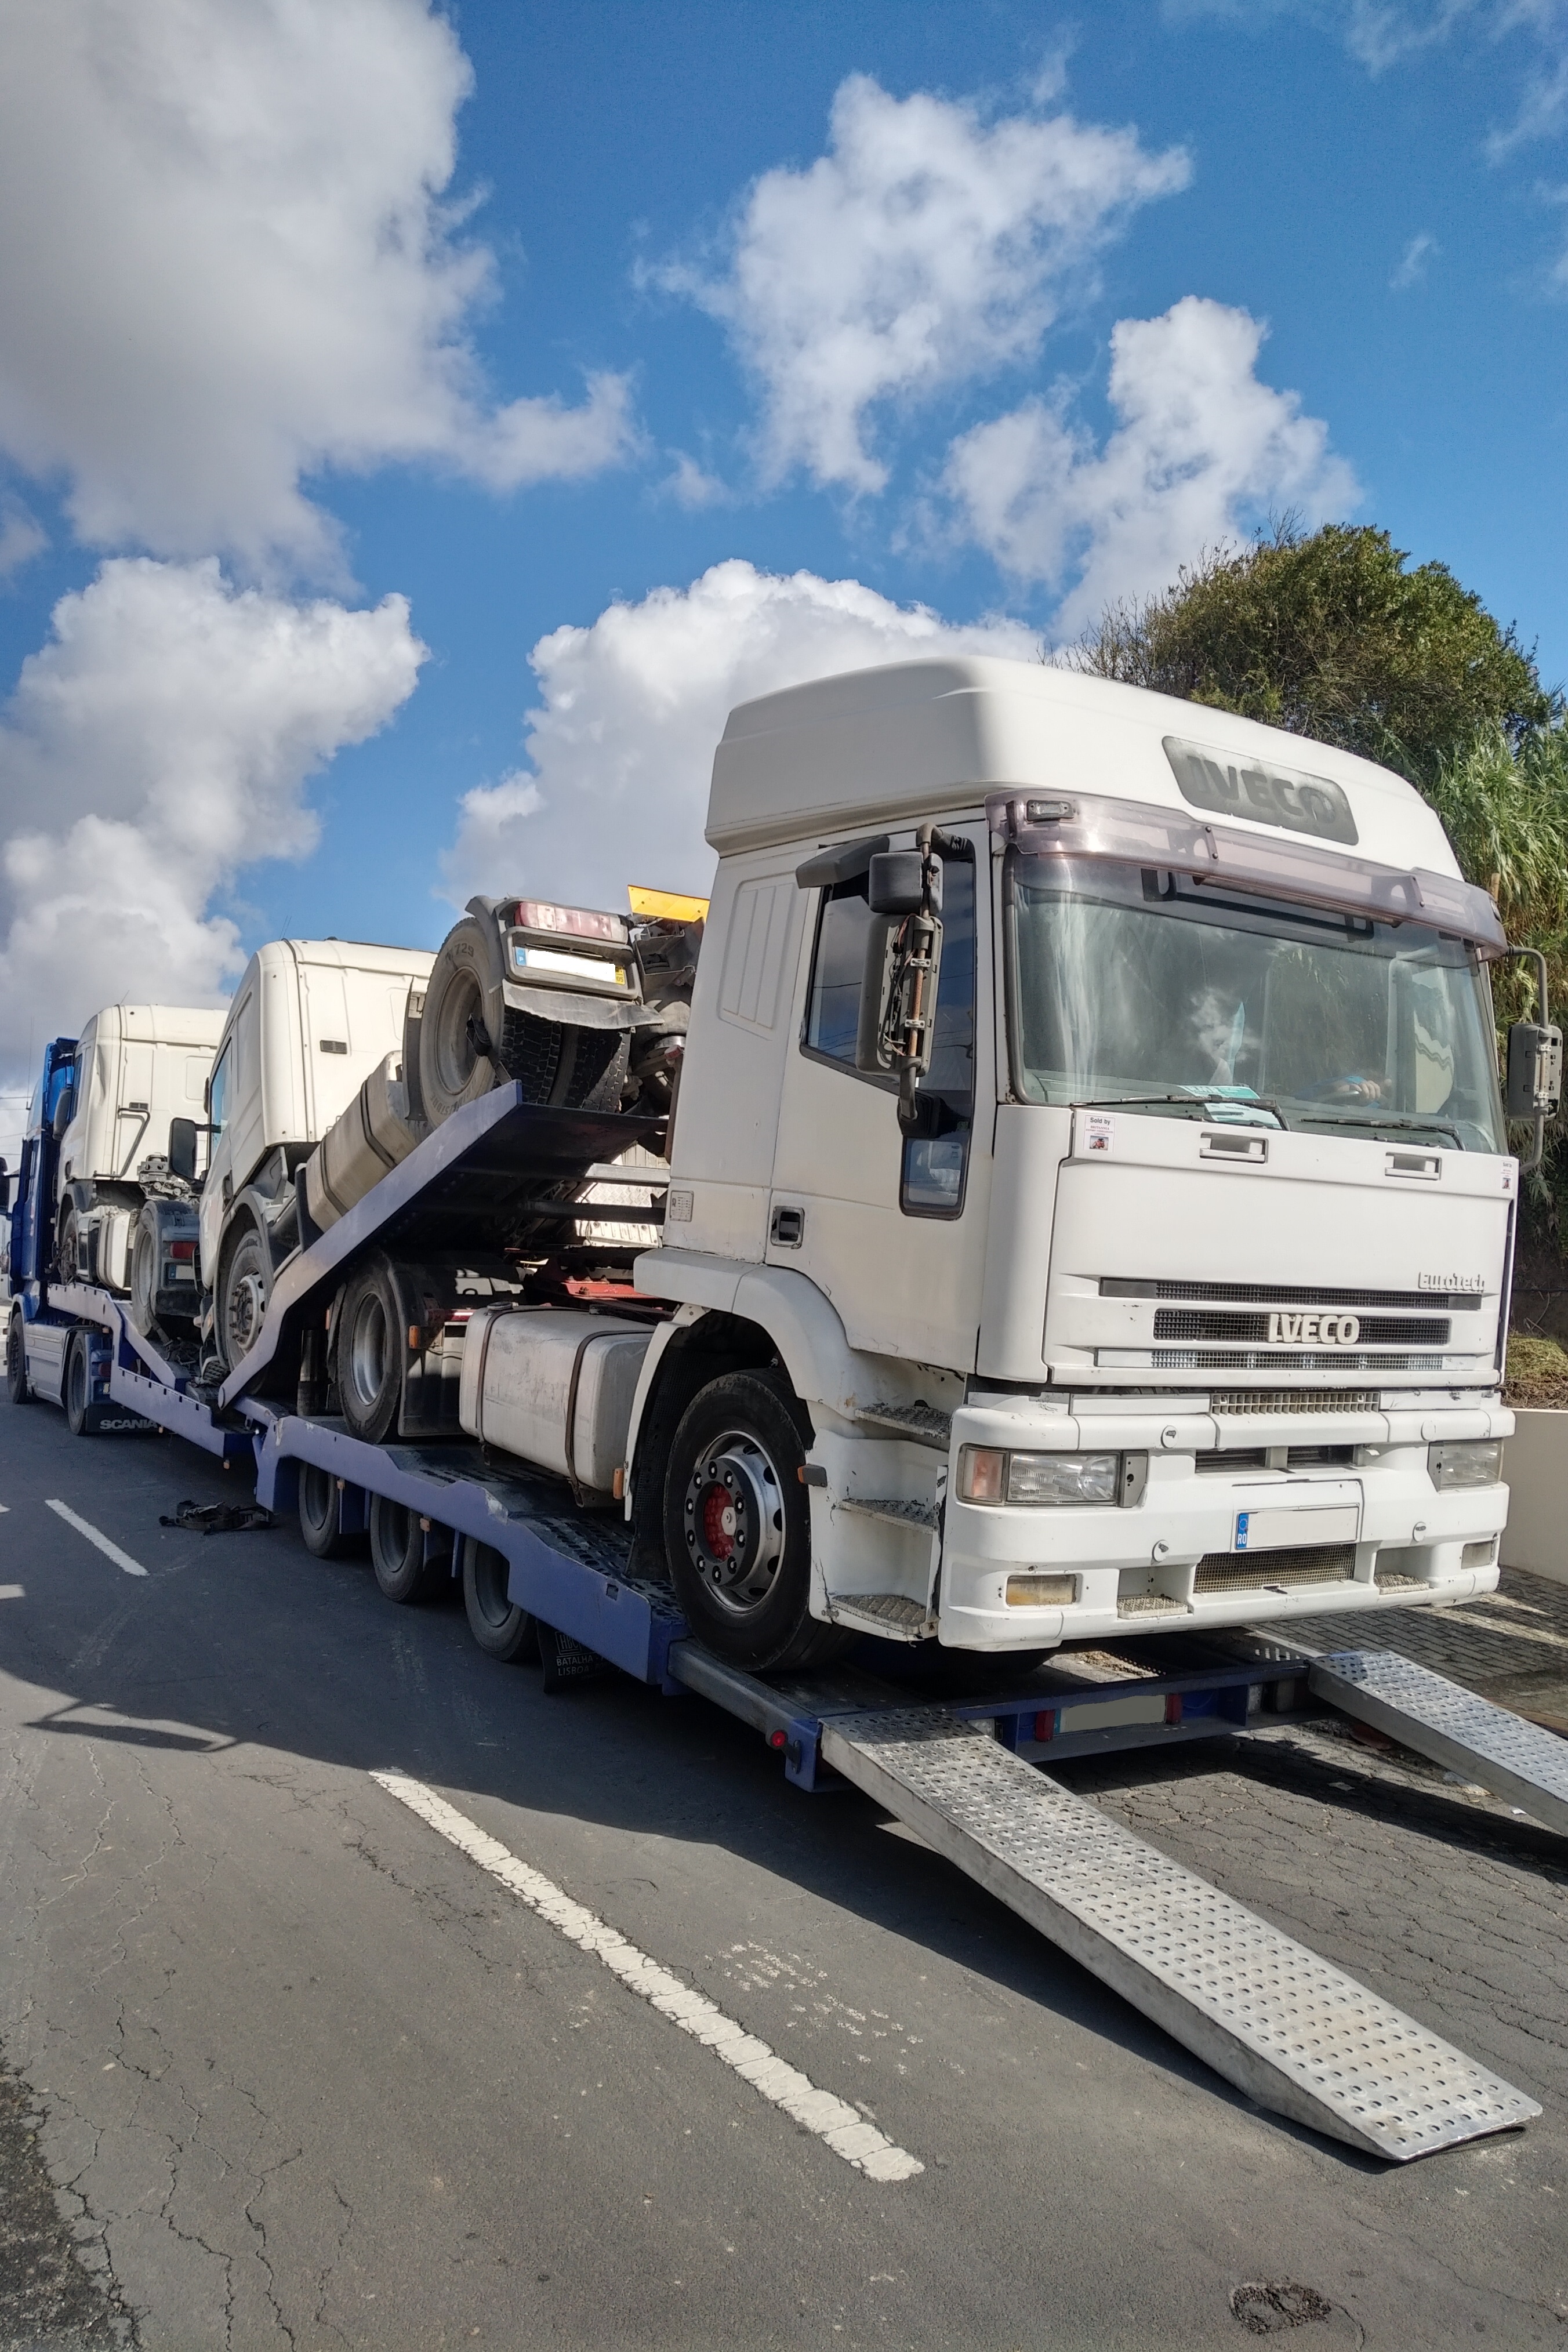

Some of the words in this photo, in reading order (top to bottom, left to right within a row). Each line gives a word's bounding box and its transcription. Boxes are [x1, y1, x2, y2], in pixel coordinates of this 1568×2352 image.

[1186, 755, 1336, 823] IVECO
[1268, 1313, 1360, 1345] IVECO
[99, 1418, 158, 1430] SCANIA
[1237, 1533, 1247, 1545] RO
[556, 1654, 594, 1667] BATALHA
[558, 1665, 590, 1676] LISBOA
